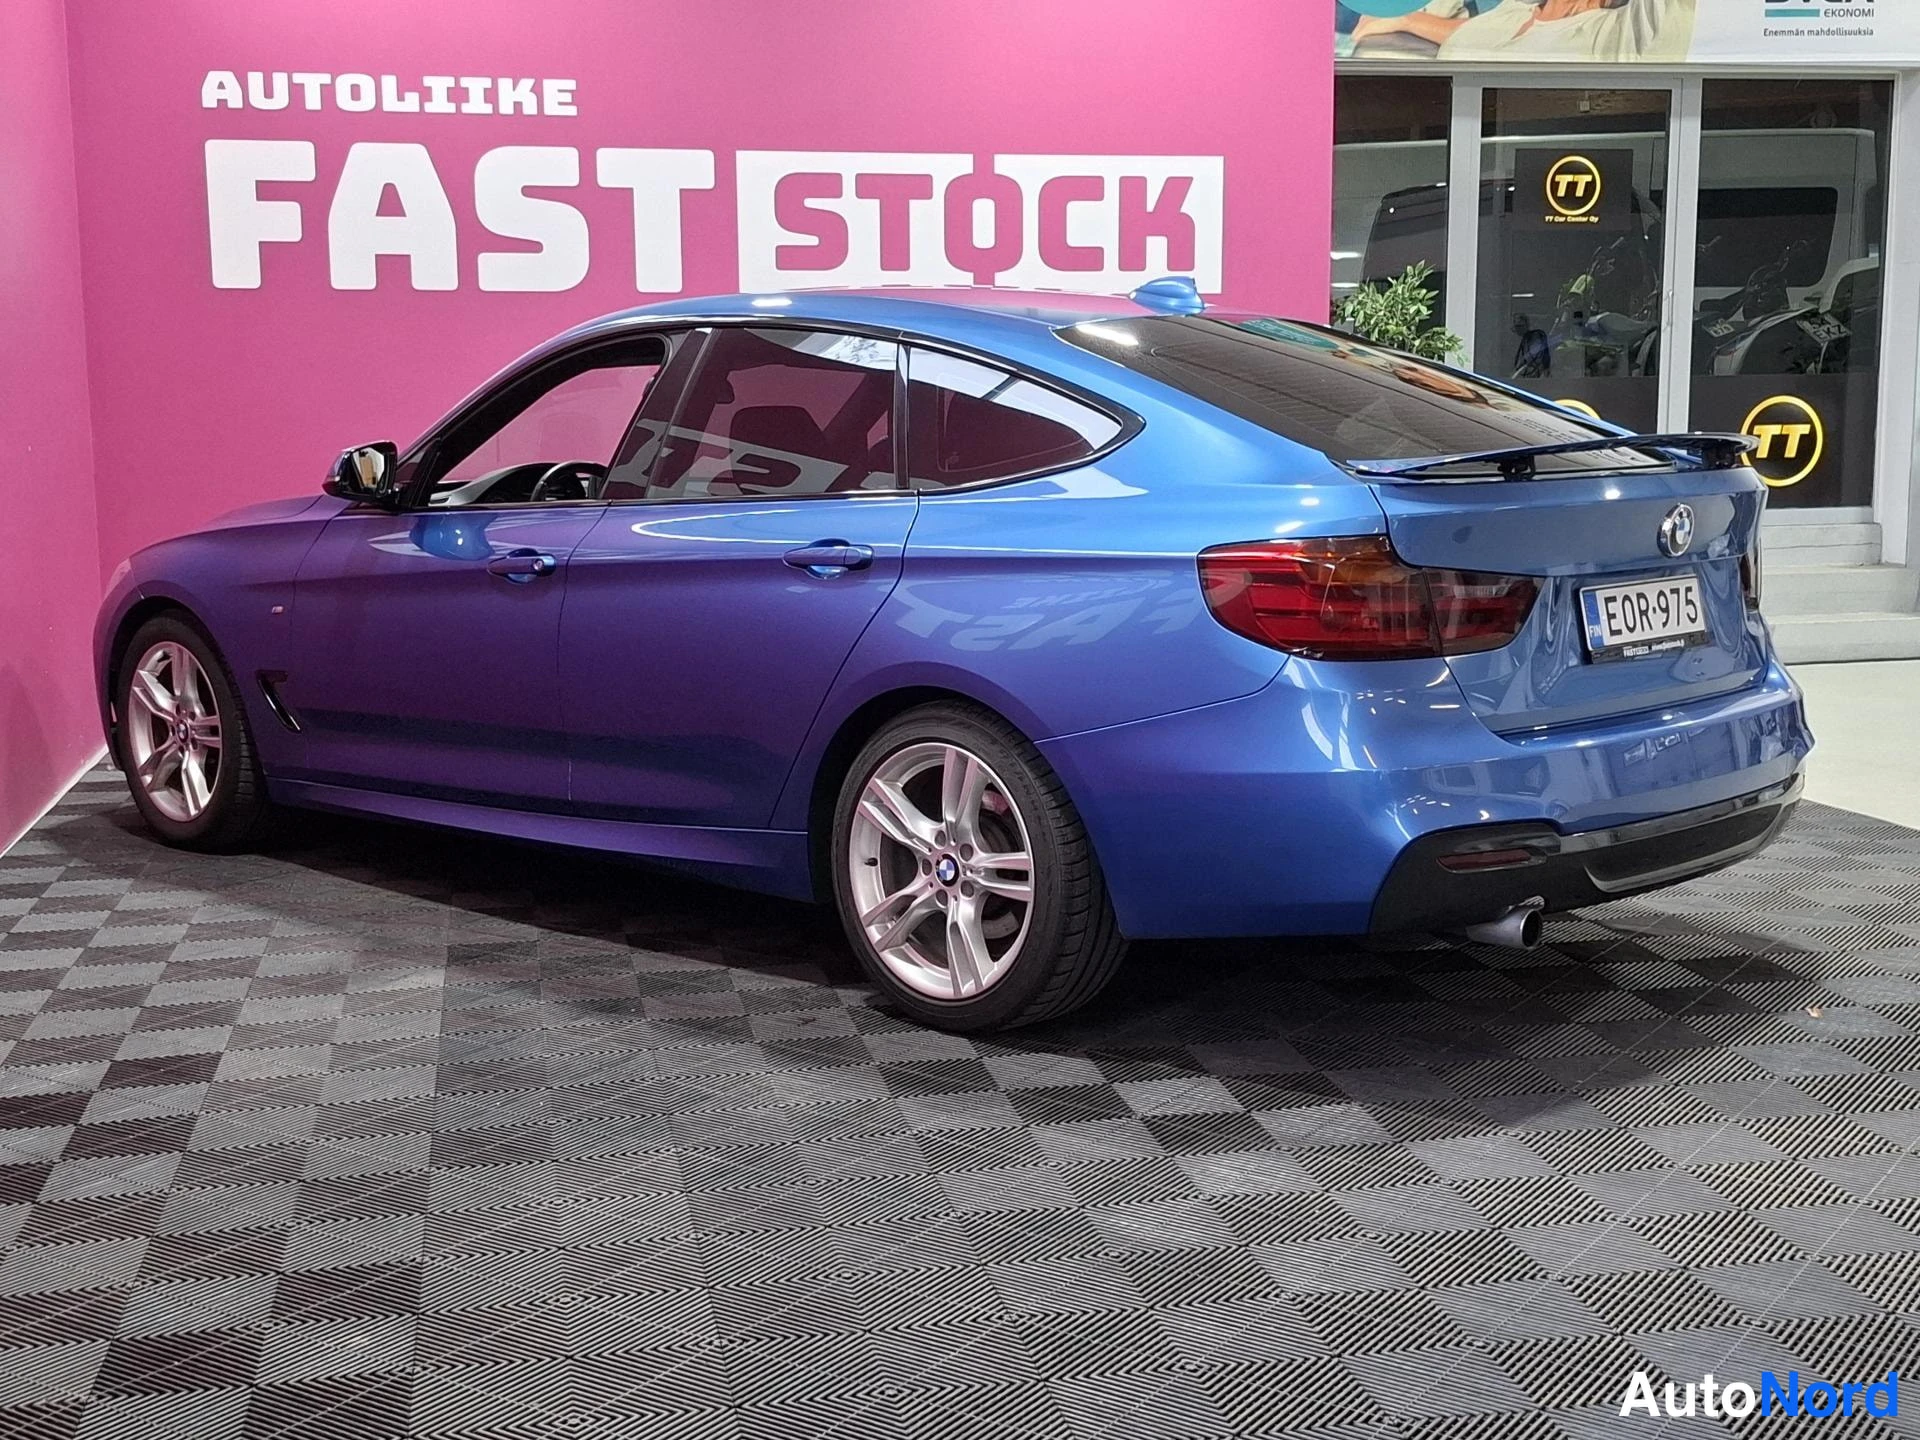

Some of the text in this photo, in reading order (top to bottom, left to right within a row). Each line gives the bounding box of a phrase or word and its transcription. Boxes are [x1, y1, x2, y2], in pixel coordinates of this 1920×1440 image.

[1763, 26, 1874, 37] Enemmän mahdollisuuksia
[200, 70, 578, 116] AUTOLIIKE
[1555, 174, 1593, 197] TT
[204, 138, 1196, 293] FAST STOCK
[1753, 423, 1812, 459] TT
[1603, 585, 1698, 637] EOR-975
[1588, 623, 1602, 638] FIN
